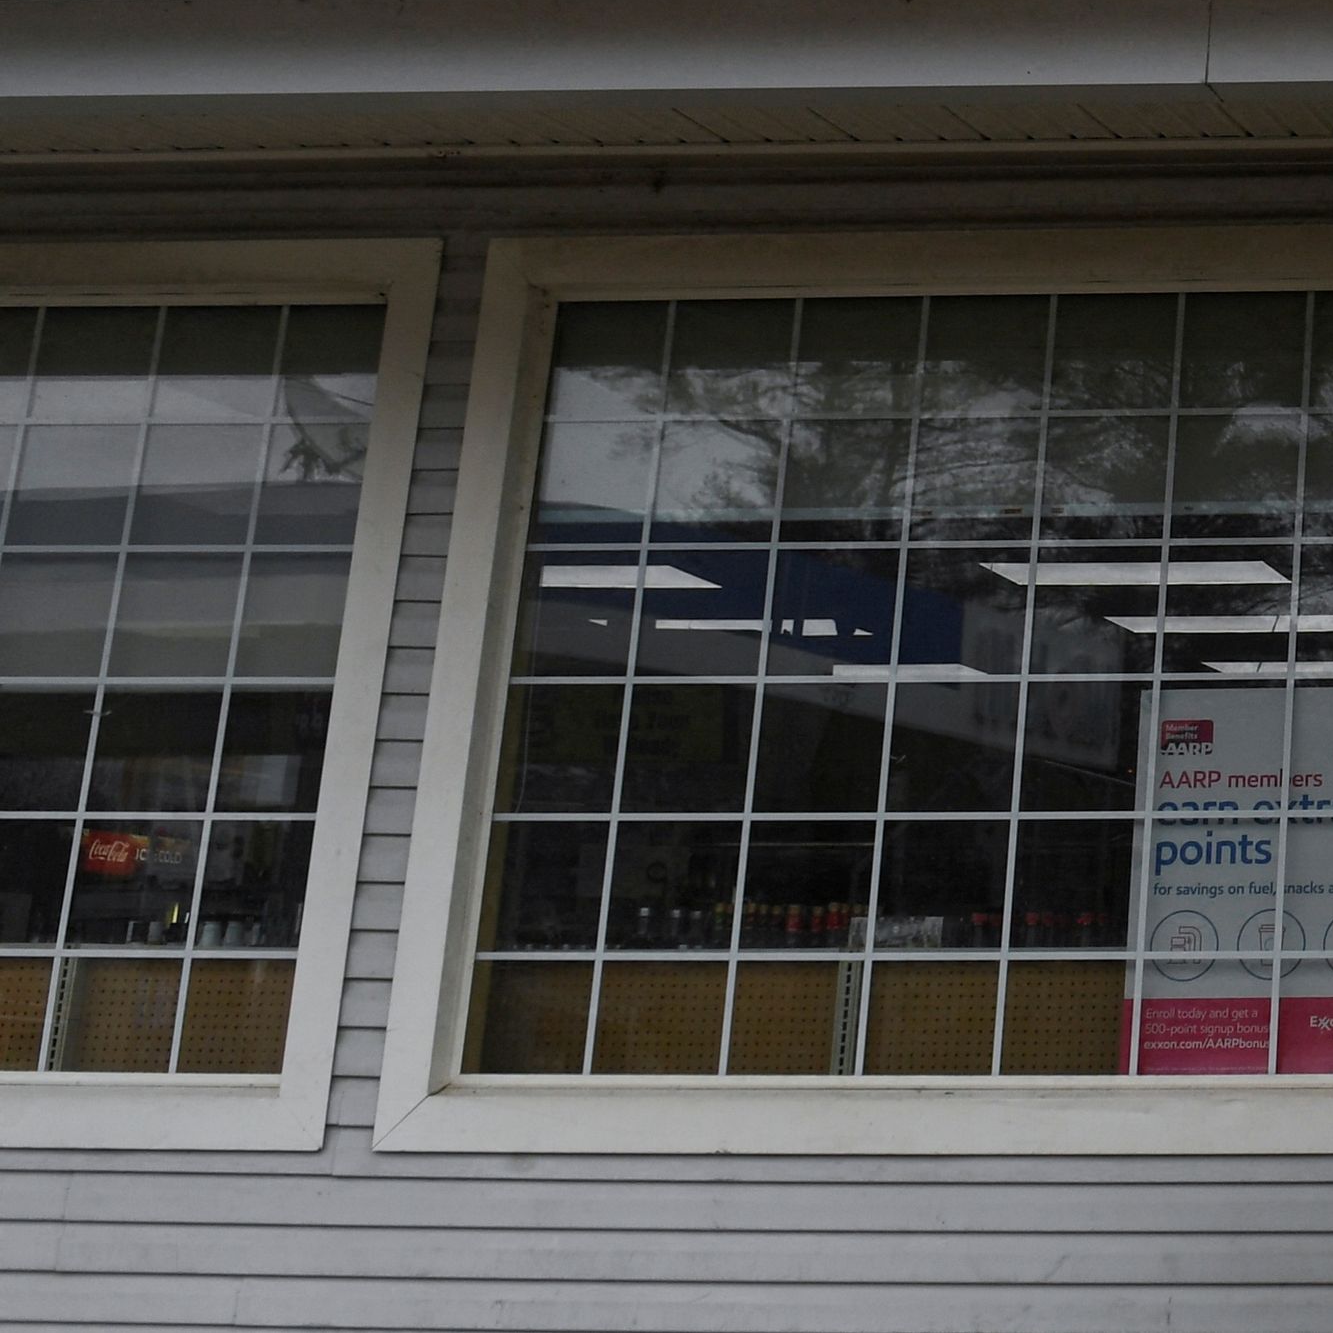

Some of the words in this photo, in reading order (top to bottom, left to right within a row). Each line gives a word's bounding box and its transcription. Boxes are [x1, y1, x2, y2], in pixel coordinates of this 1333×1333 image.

[1165, 723, 1199, 732] Member
[1165, 732, 1198, 740] Benefits
[1161, 741, 1213, 756] AARP
[1160, 770, 1222, 789] AARP
[1228, 768, 1323, 788] members
[1157, 799, 1239, 826] earn
[1154, 830, 1272, 876] points
[1153, 882, 1174, 896] for
[1176, 882, 1224, 899] savings
[1228, 885, 1245, 896] on
[1248, 881, 1277, 898] fuel,
[1284, 880, 1325, 895] nacks
[1145, 1008, 1176, 1020] Enroll
[1178, 1008, 1207, 1021] today
[1209, 1008, 1229, 1019] and
[1232, 1009, 1249, 1022] get
[1251, 1010, 1258, 1018] a
[1144, 1023, 1197, 1037] 500-point
[1200, 1023, 1234, 1037] signup
